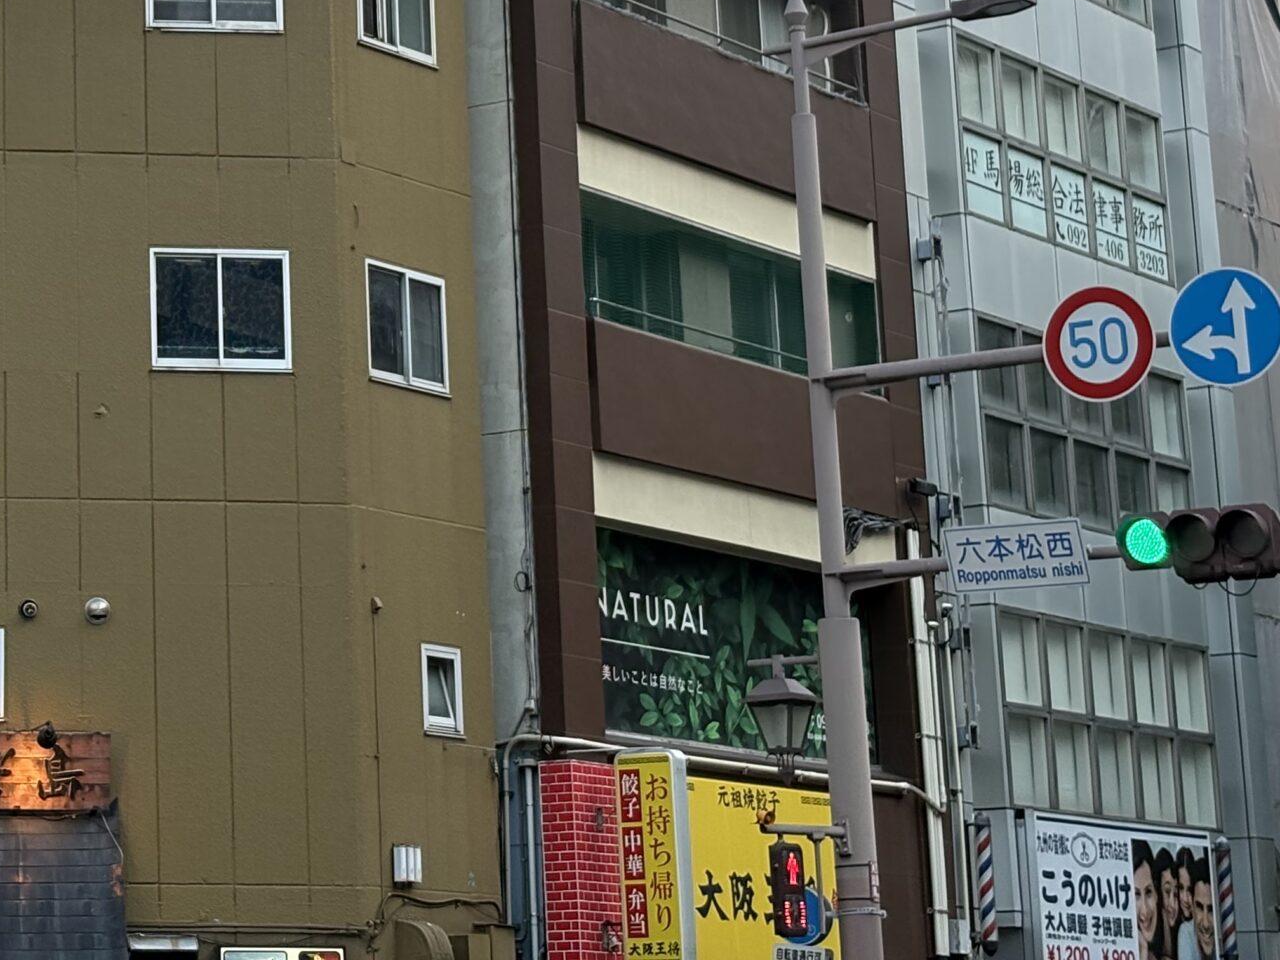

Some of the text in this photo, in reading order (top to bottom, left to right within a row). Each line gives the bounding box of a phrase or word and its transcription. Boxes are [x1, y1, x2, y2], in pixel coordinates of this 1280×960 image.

[1068, 317, 1129, 369] 50
[956, 531, 1074, 565] 六本松西
[957, 560, 1084, 585] Ropponmatsu nishi
[598, 586, 709, 636] NATURAL
[602, 663, 704, 695] 美しいことは自然なこと
[621, 773, 640, 819] 餃子
[717, 785, 781, 814] 元祖焼餃子
[624, 829, 644, 878] 中華
[645, 773, 675, 933] お持ち帰り
[628, 888, 646, 935] 弁当
[1041, 868, 1132, 912] こうのいけ
[628, 942, 681, 958] 大阪王将
